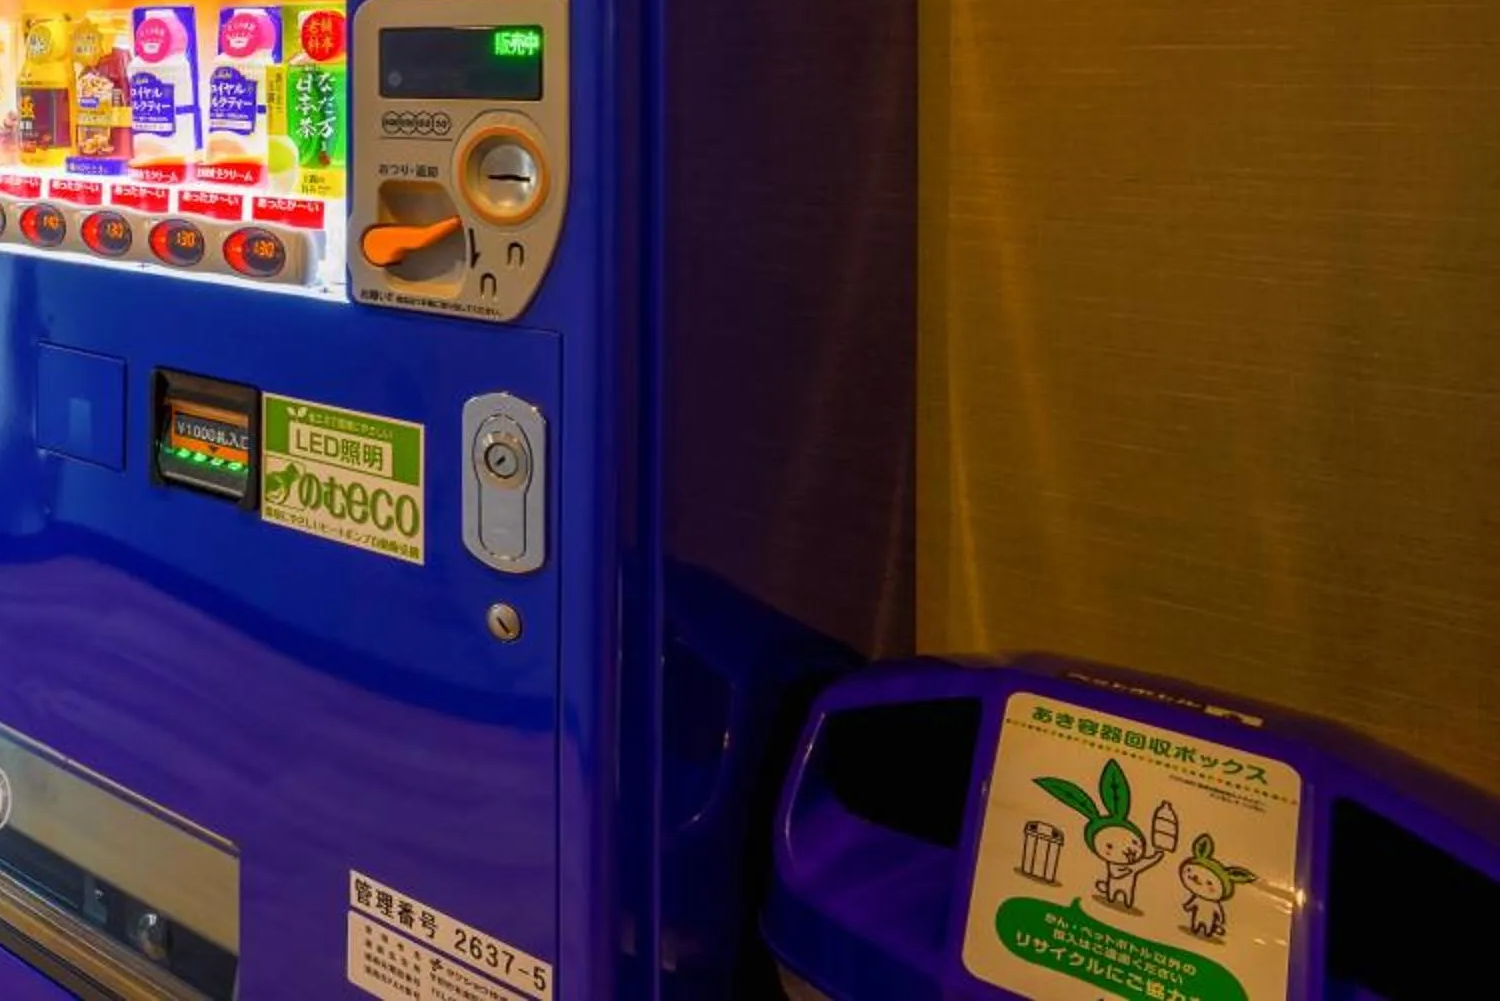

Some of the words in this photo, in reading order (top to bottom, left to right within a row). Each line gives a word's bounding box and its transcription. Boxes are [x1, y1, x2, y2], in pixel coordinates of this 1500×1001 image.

[296, 428, 384, 472] LED照明
[1031, 704, 1269, 786] あき容器回収ボックス
[354, 877, 439, 940] 管理番号
[454, 927, 547, 992] 2637-5
[1015, 929, 1202, 1001] リサイクルにご協力
